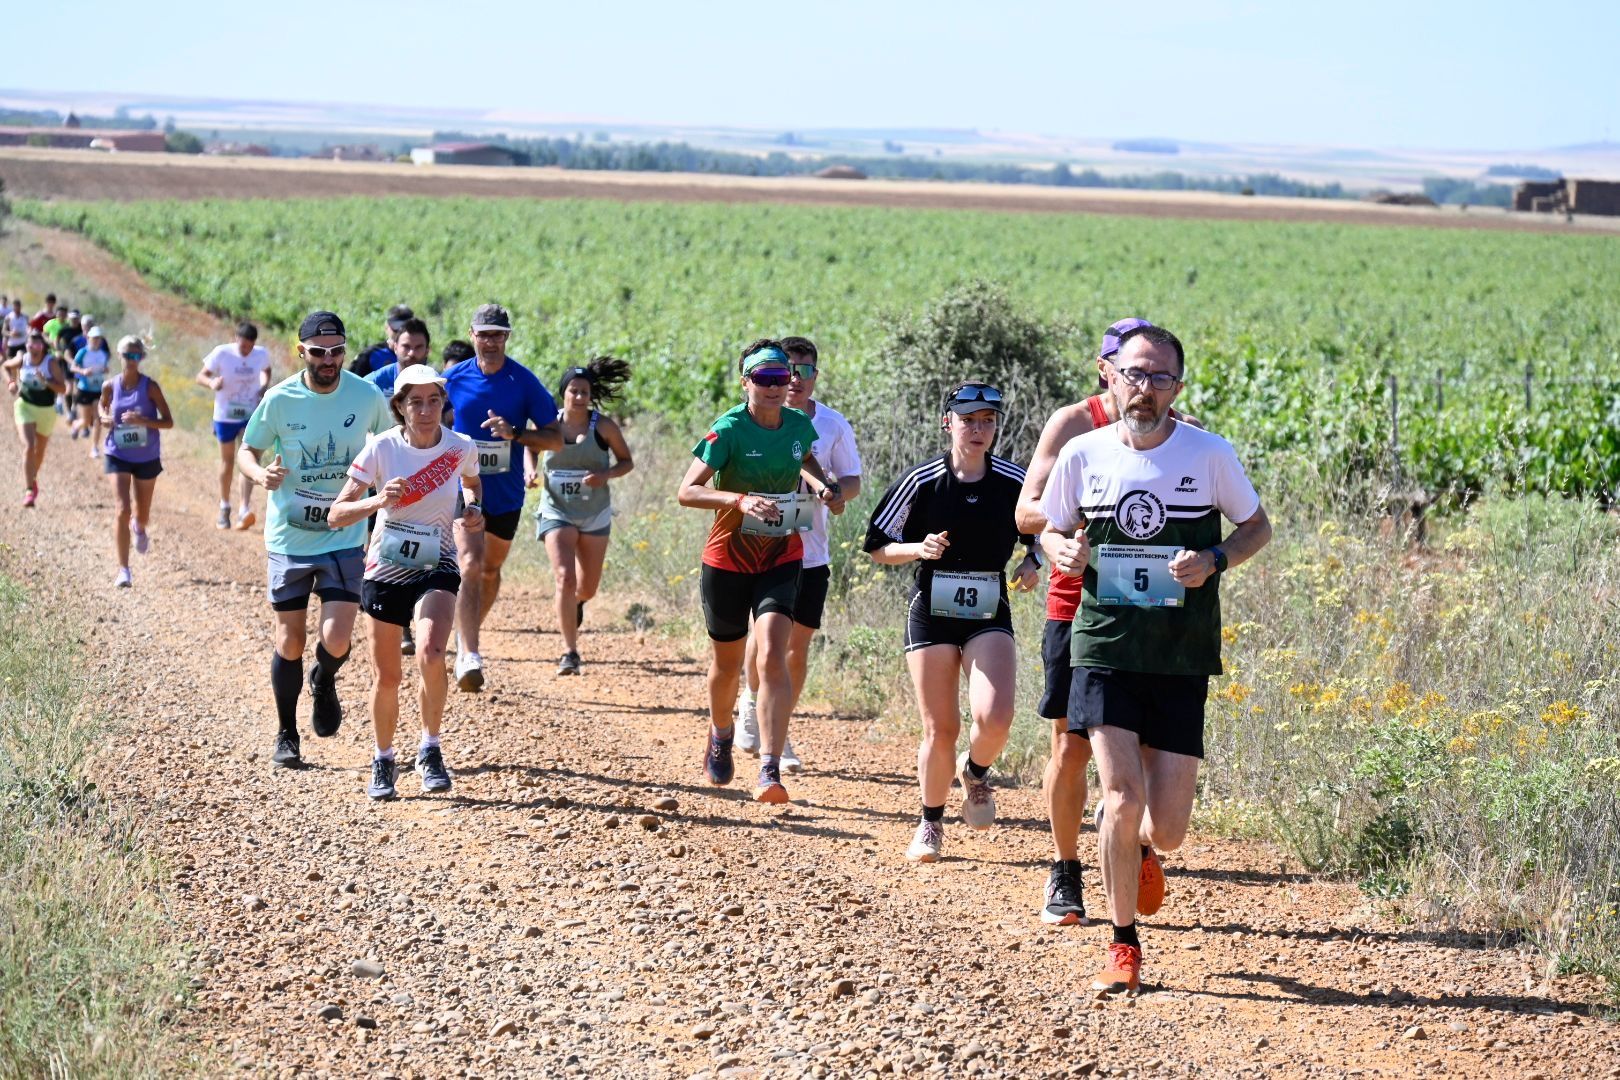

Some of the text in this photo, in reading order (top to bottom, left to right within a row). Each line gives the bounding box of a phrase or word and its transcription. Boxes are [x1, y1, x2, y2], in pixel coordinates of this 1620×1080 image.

[478, 453, 498, 467] 00
[404, 457, 451, 496] DESPENSA
[560, 481, 581, 495] 152
[399, 539, 421, 560] 47
[1133, 567, 1150, 592] 5
[953, 586, 979, 608] 43
